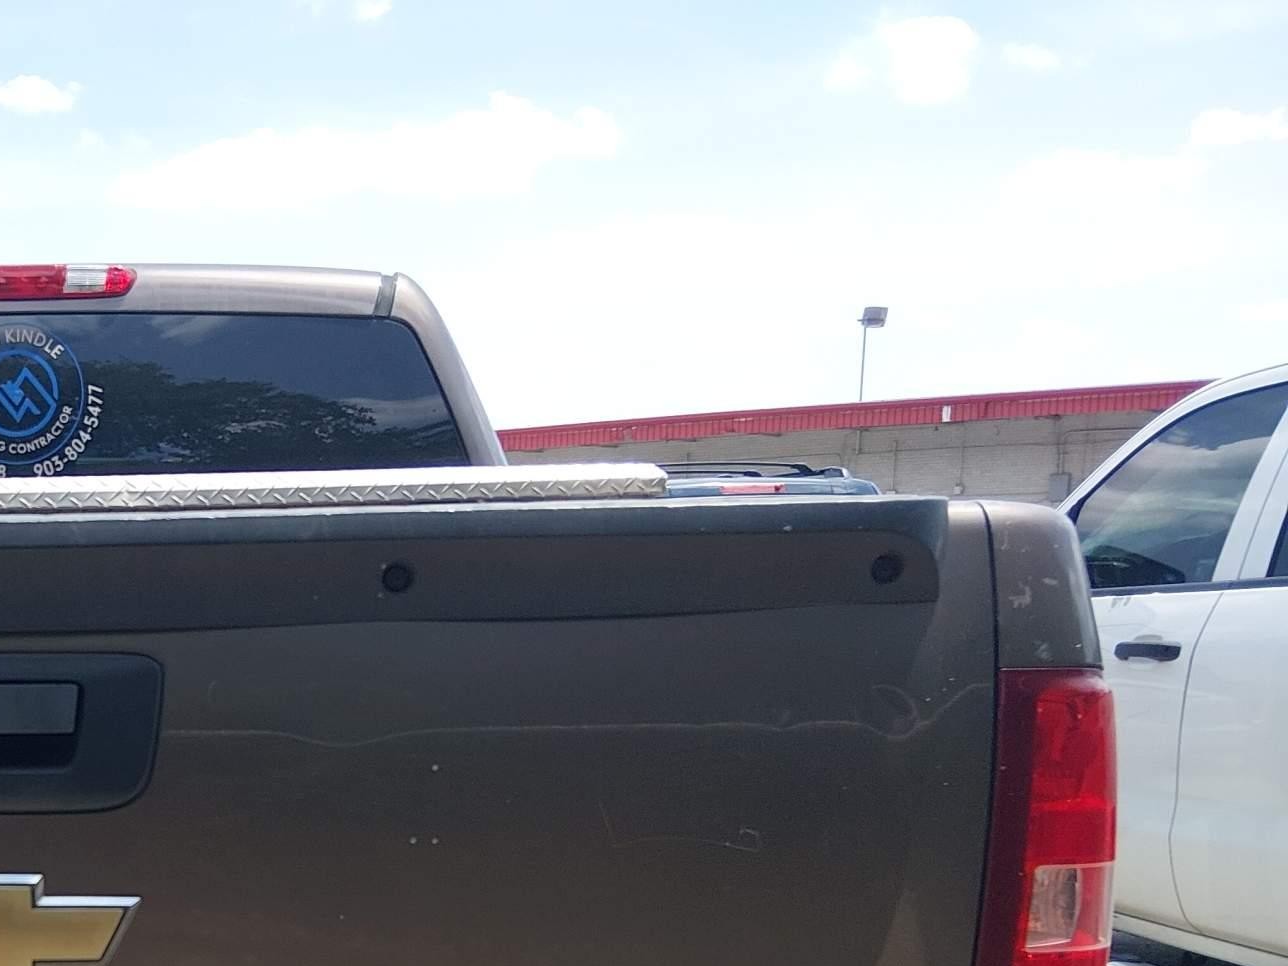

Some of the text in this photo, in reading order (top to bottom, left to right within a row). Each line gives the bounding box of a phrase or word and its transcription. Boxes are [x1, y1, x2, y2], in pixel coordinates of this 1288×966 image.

[4, 328, 65, 360] KINDLE
[8, 405, 73, 454] CONTRACTOR
[33, 384, 104, 477] 903-804-5477
